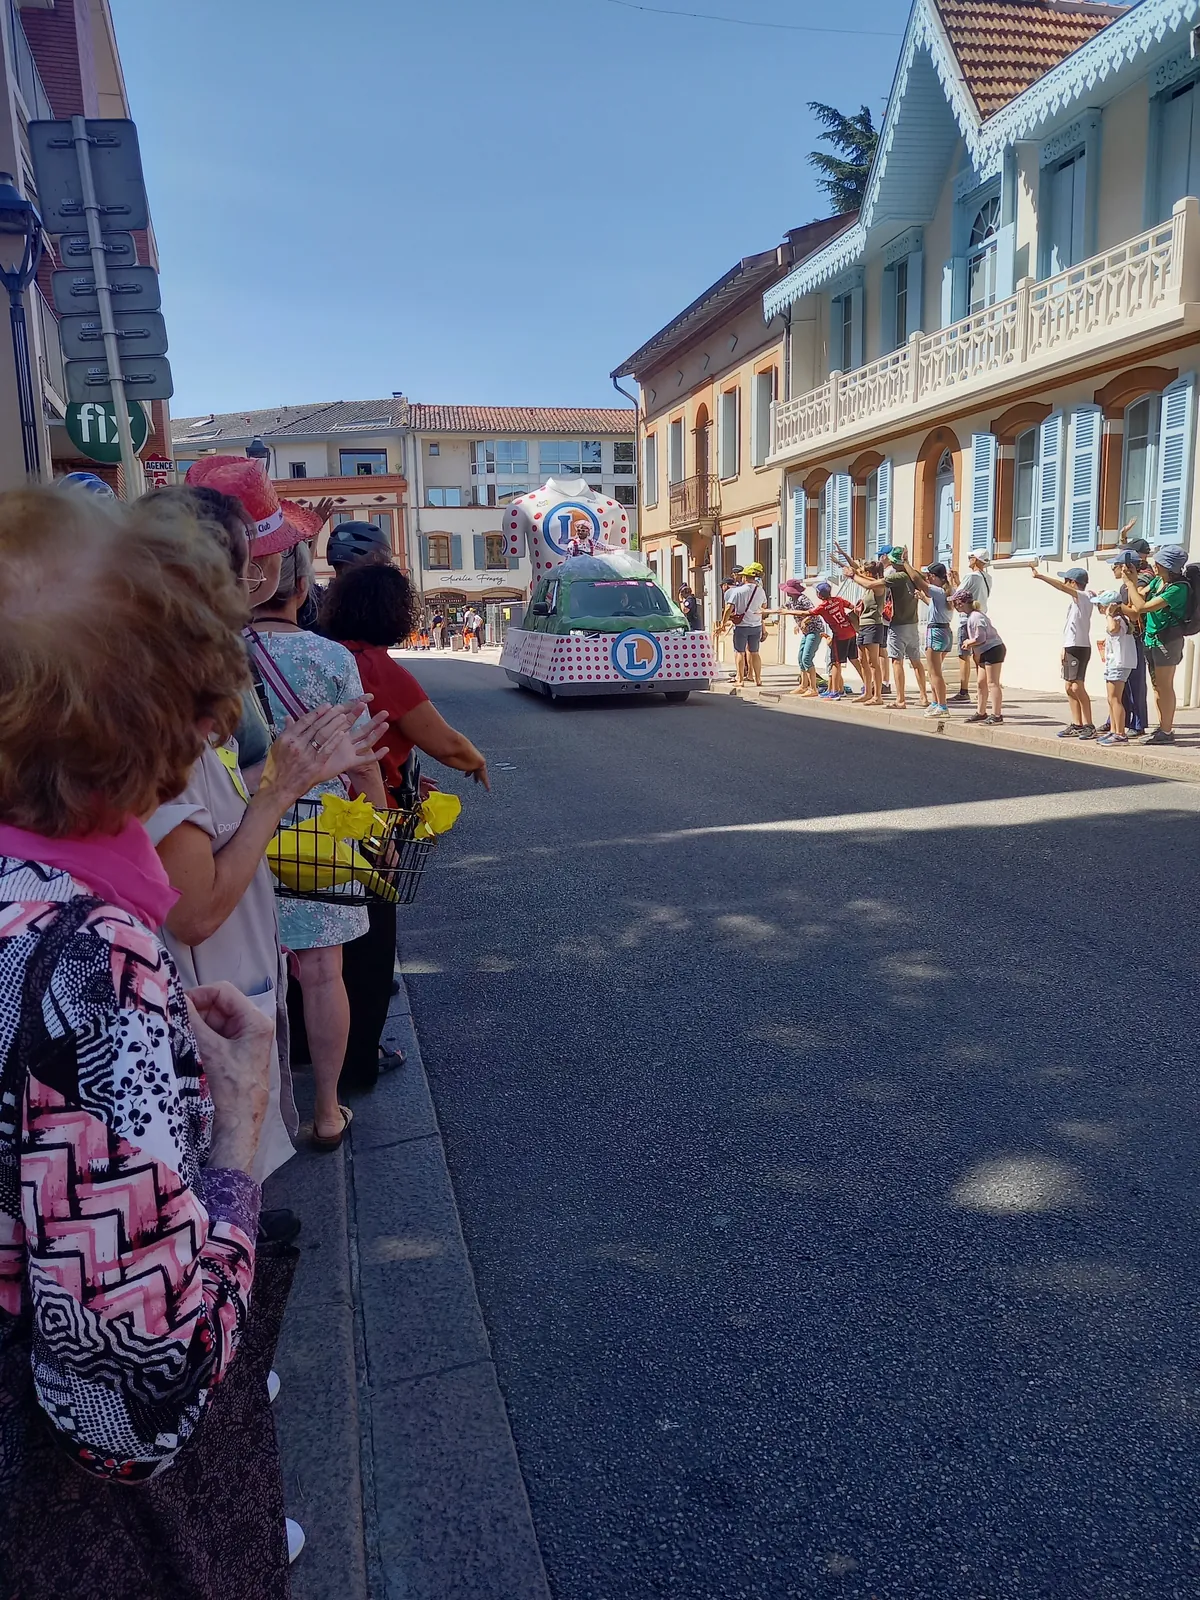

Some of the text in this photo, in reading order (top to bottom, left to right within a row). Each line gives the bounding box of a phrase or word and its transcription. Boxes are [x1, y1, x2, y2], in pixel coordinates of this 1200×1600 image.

[77, 403, 136, 444] fix
[146, 461, 174, 470] AGENCE
[258, 521, 271, 533] Club
[832, 611, 846, 624] 13
